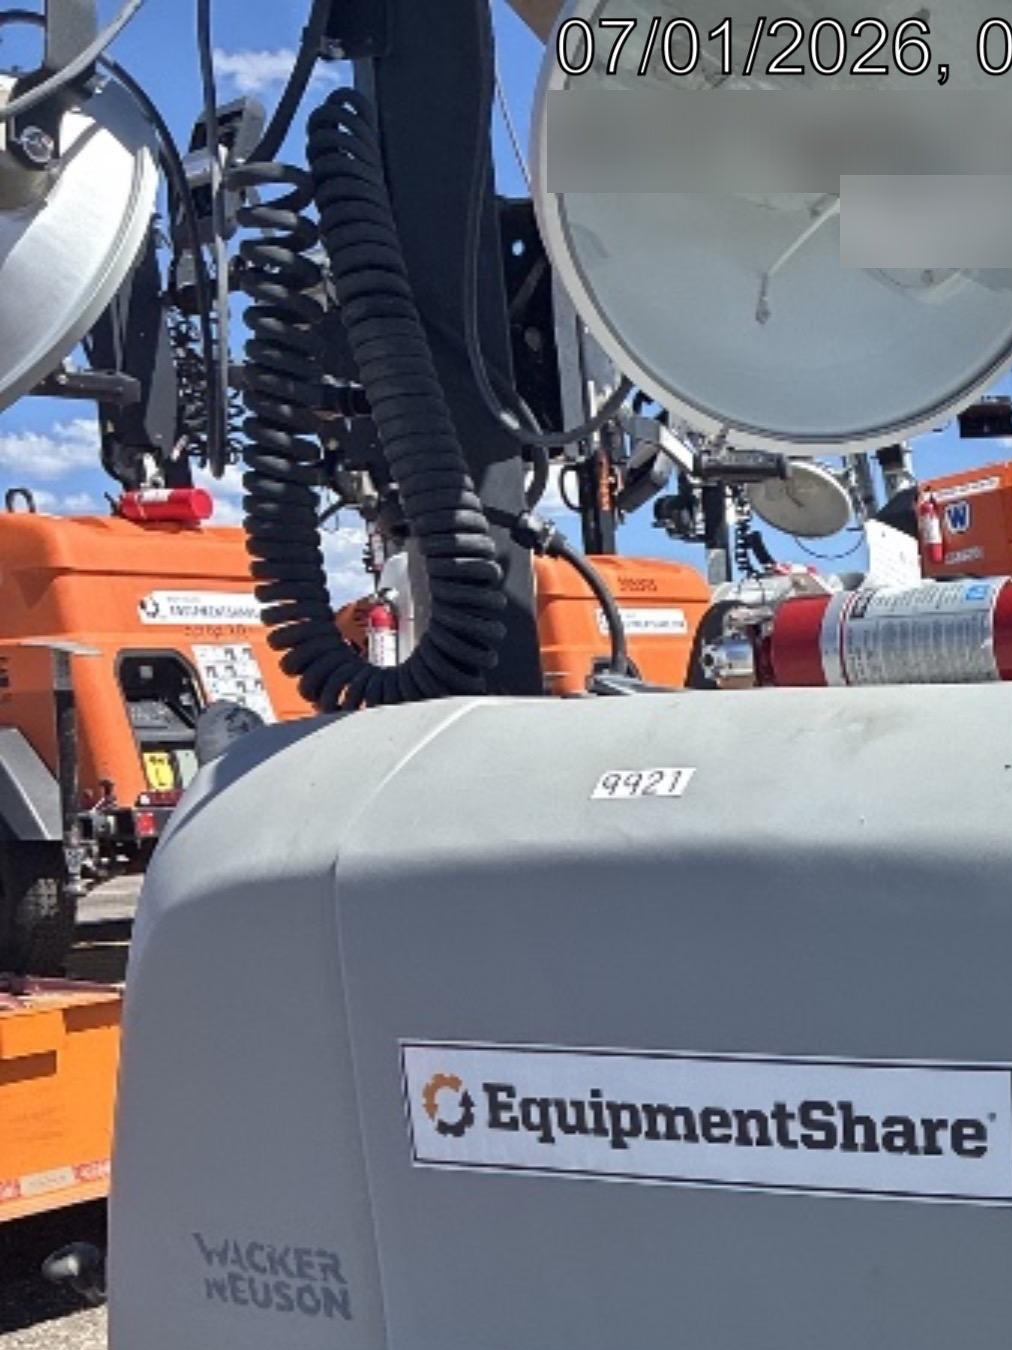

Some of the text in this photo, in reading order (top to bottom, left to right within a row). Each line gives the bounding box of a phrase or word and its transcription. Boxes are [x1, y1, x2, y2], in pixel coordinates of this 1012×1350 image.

[482, 1082, 990, 1158] EquipmentShare
[191, 1232, 349, 1285] WACKER
[203, 1271, 353, 1321] NEUSON
